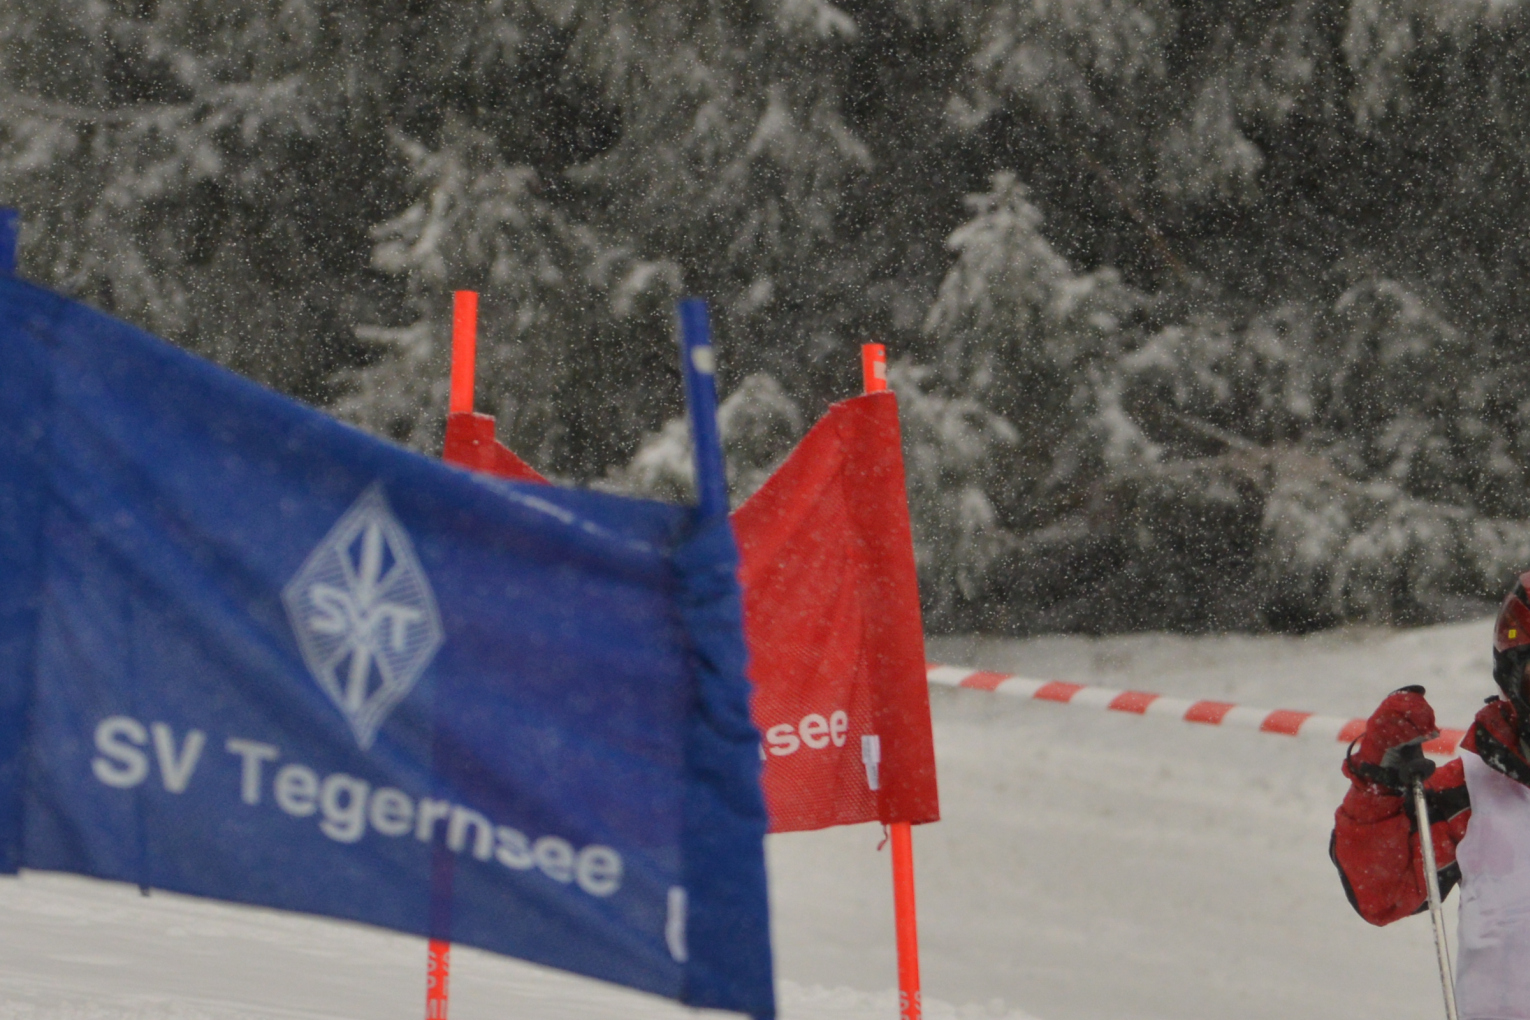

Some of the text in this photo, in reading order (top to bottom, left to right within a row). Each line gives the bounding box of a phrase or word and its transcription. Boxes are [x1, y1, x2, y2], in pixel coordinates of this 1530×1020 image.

[759, 710, 848, 761] see
[92, 715, 625, 896] SV Tegernsee
